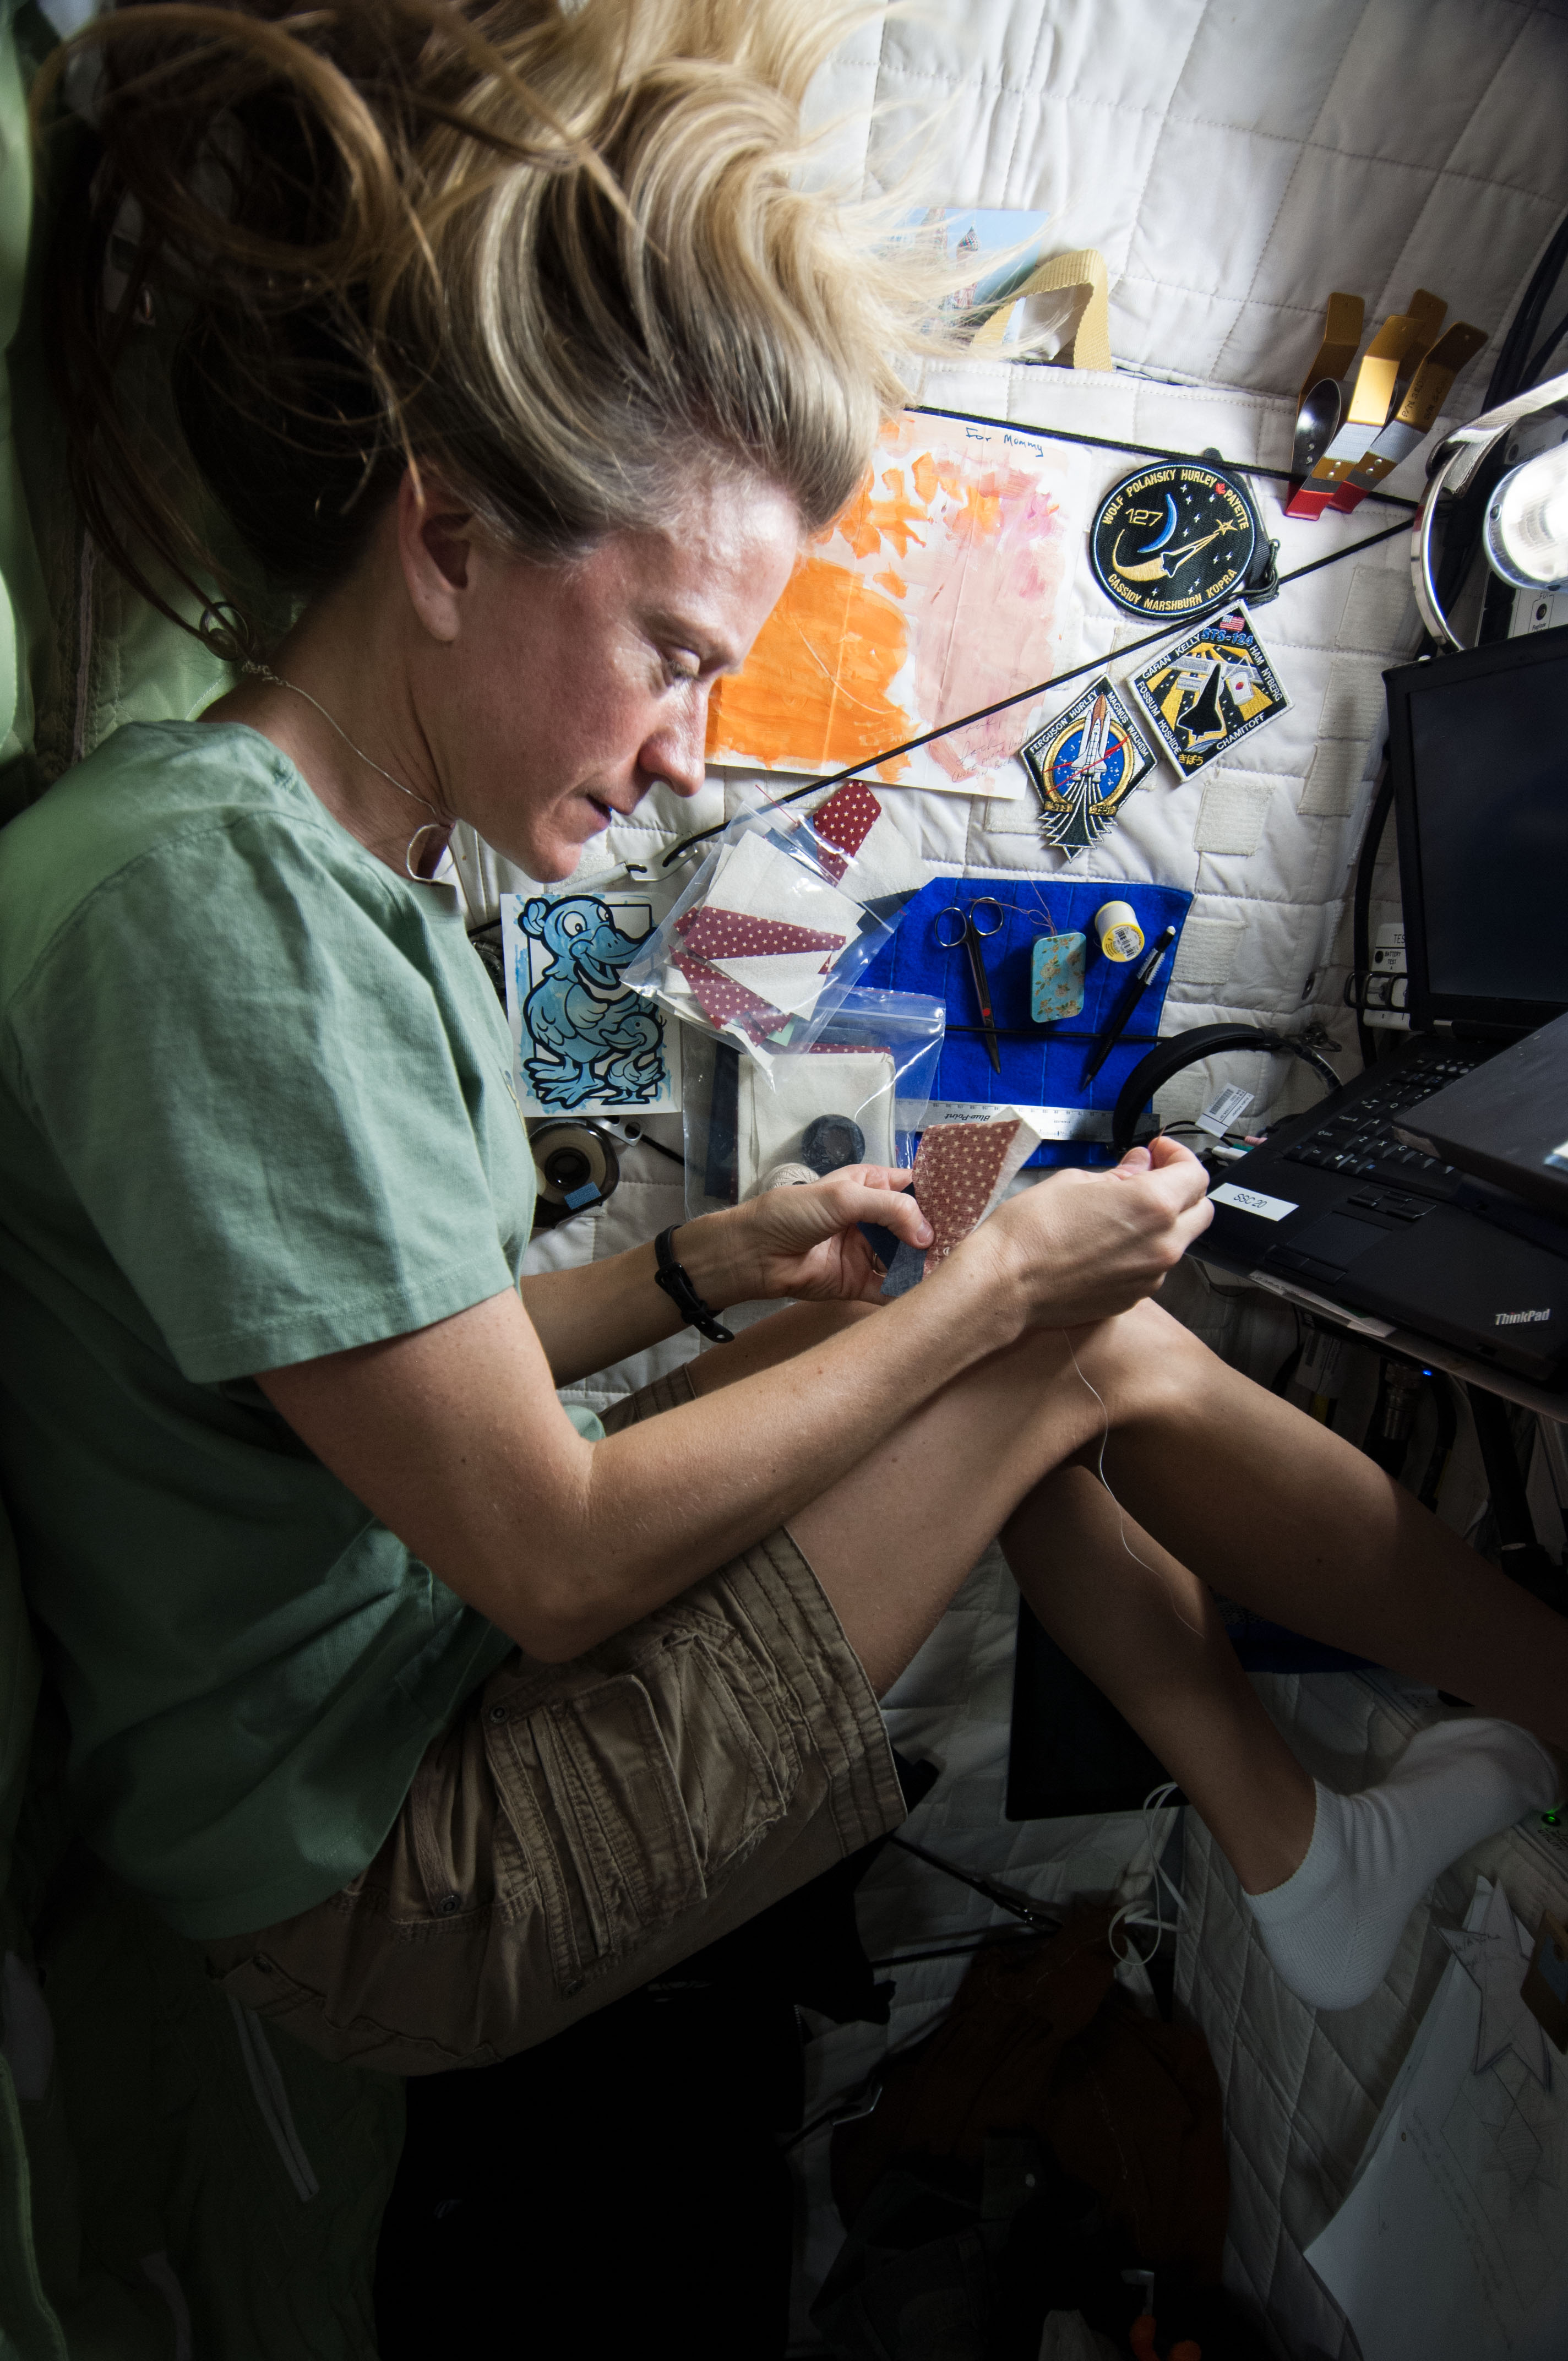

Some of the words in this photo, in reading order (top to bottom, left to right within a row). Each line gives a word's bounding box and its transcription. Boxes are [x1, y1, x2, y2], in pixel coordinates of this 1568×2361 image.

[966, 427, 991, 442] For
[1004, 434, 1043, 457] Mommy
[1102, 496, 1124, 525] WOLF
[1126, 469, 1175, 497] POLANSKY
[1180, 469, 1217, 489] HURLEY
[1224, 489, 1249, 530] PAYETTE
[1125, 508, 1163, 527] 127
[1108, 574, 1141, 605] CASSIDY
[1144, 594, 1202, 611] MARSHBURN
[1207, 569, 1238, 599] KOPRA
[1142, 655, 1171, 679] GARAN
[1175, 634, 1201, 657] KELLY
[1201, 628, 1254, 646] STS-124
[1250, 644, 1264, 666] HAM
[1262, 667, 1283, 701] NYBERG
[1029, 717, 1069, 754] FERGUSON
[1069, 690, 1098, 720] HURLEY
[1108, 692, 1129, 724] MAGNUS
[1126, 725, 1149, 758] WALHEIM
[1136, 681, 1160, 717] FOSSUM
[1158, 720, 1182, 755] HOSHIDE
[1216, 714, 1265, 750] CHAMITOFF
[1233, 1193, 1255, 1205] SSC
[1251, 1199, 1267, 1209] 20
[1495, 1308, 1550, 1325] ThinkPad
